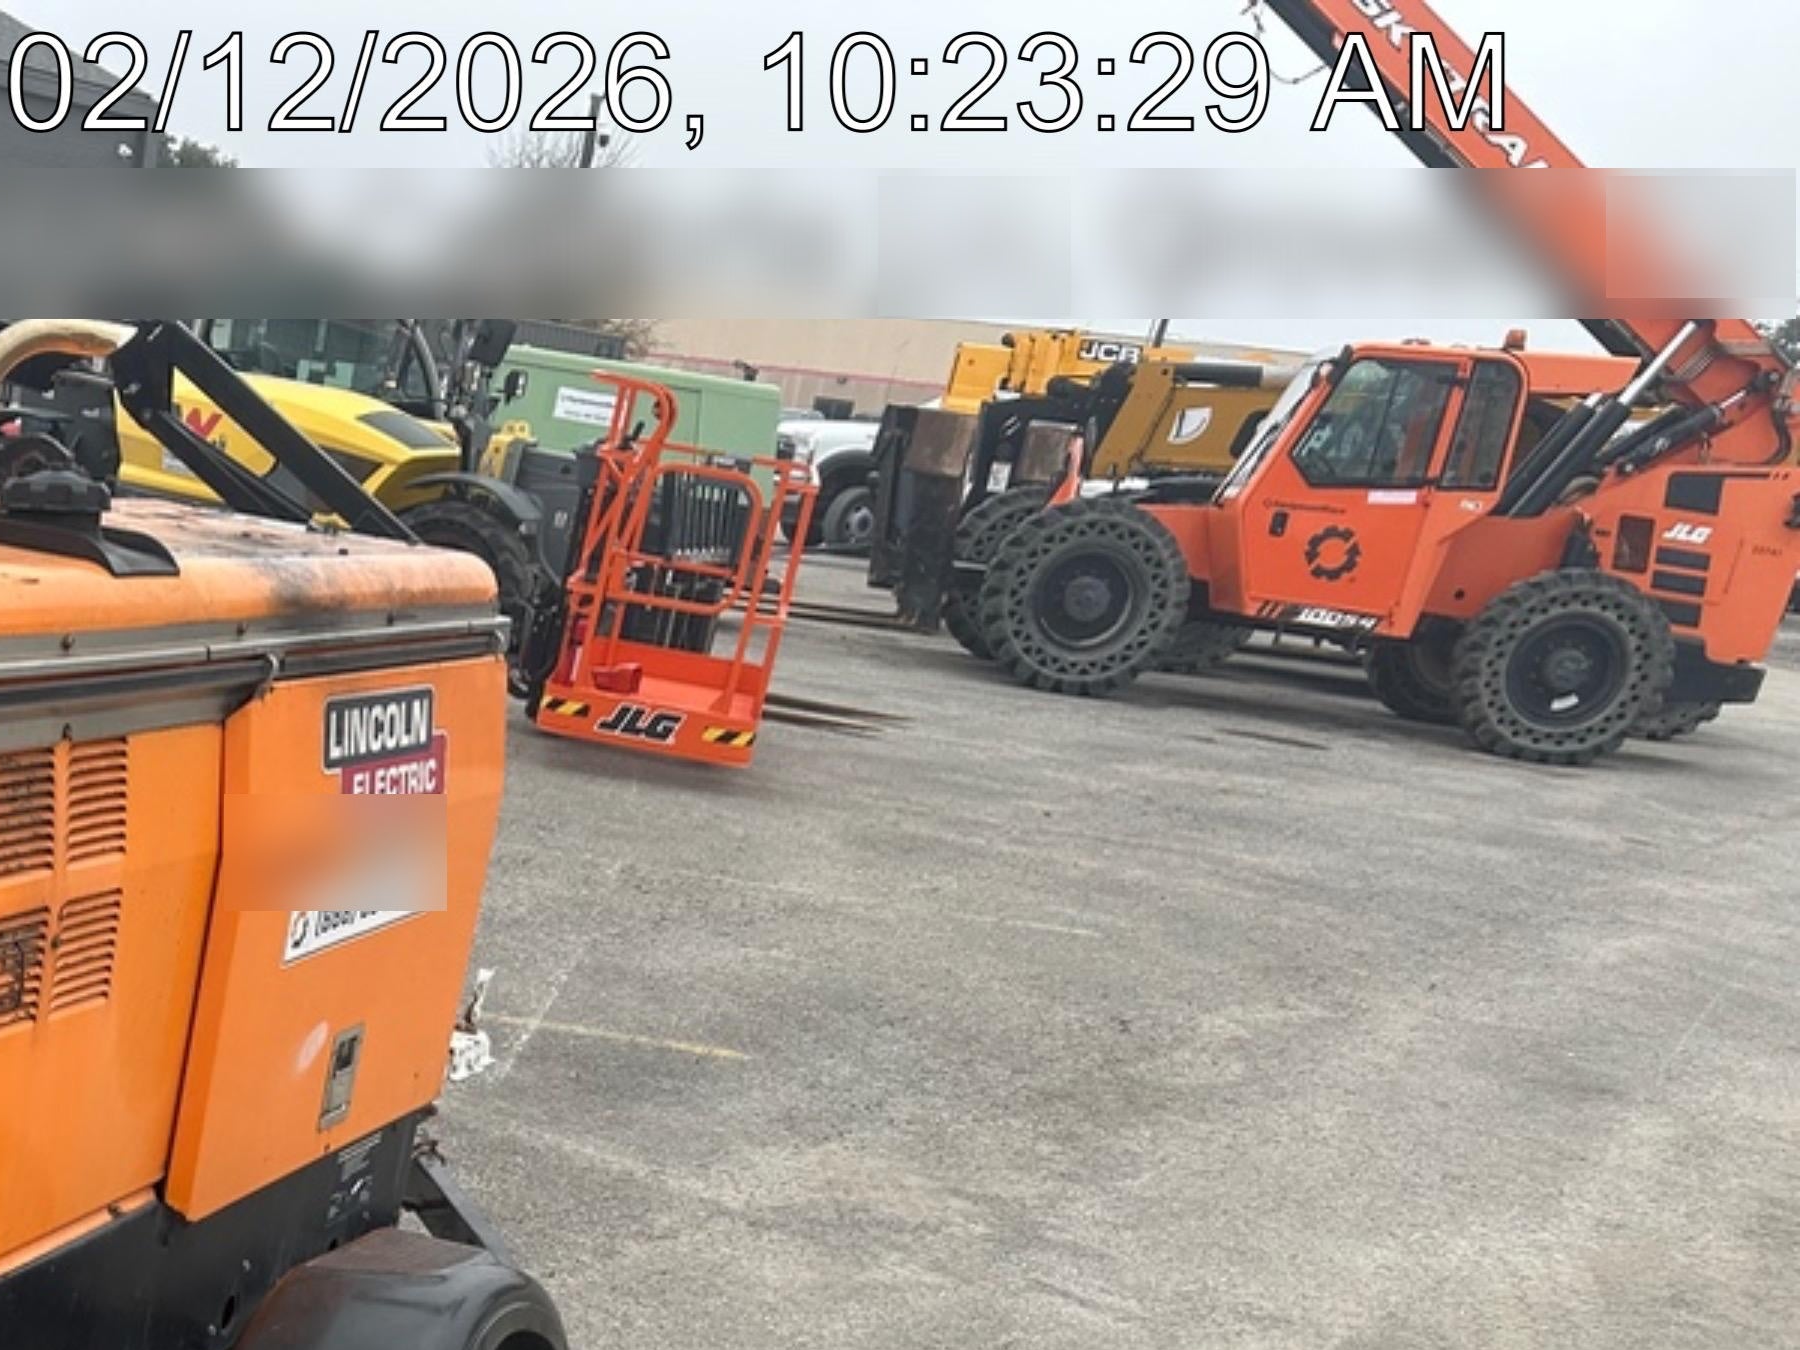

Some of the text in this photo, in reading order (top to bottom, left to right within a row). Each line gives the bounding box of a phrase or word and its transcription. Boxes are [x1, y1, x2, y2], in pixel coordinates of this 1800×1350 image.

[1079, 340, 1141, 365] JCB
[1661, 521, 1714, 545] JLG
[327, 698, 430, 761] LINCOLN
[595, 703, 686, 743] JLG
